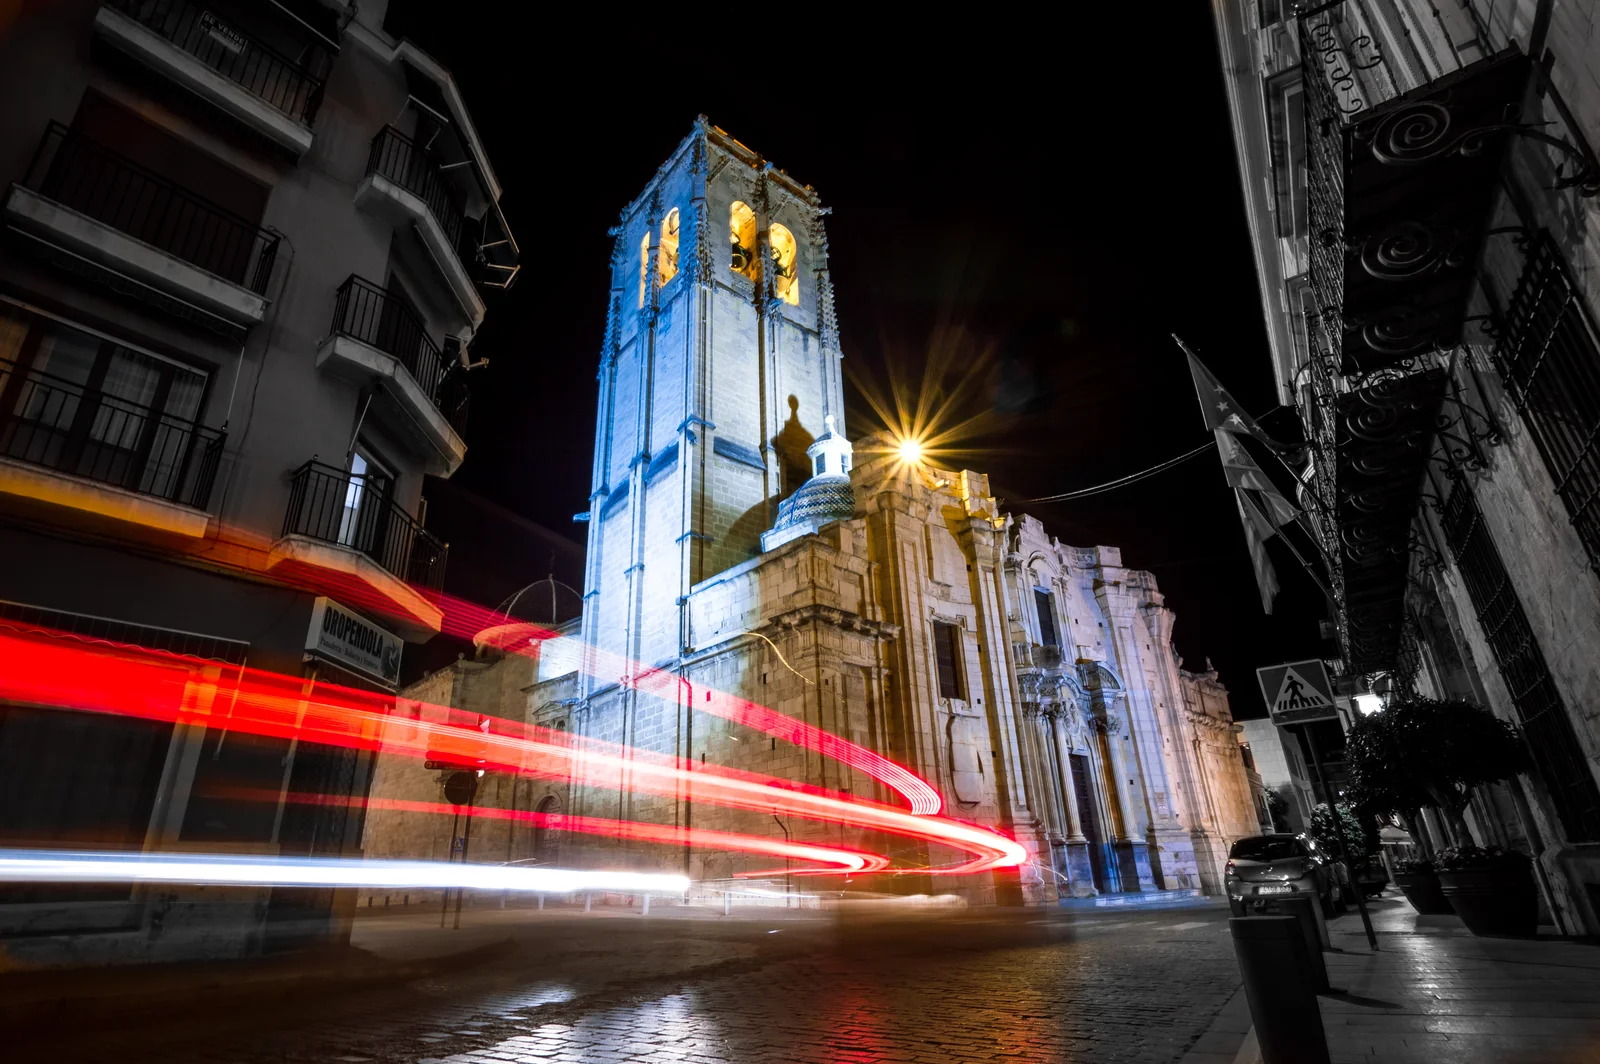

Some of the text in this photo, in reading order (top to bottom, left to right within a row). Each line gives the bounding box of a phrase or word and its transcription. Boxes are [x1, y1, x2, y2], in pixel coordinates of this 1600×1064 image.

[204, 14, 215, 24] SE
[218, 23, 244, 44] VENDE
[323, 606, 383, 658] OROPENDOLA
